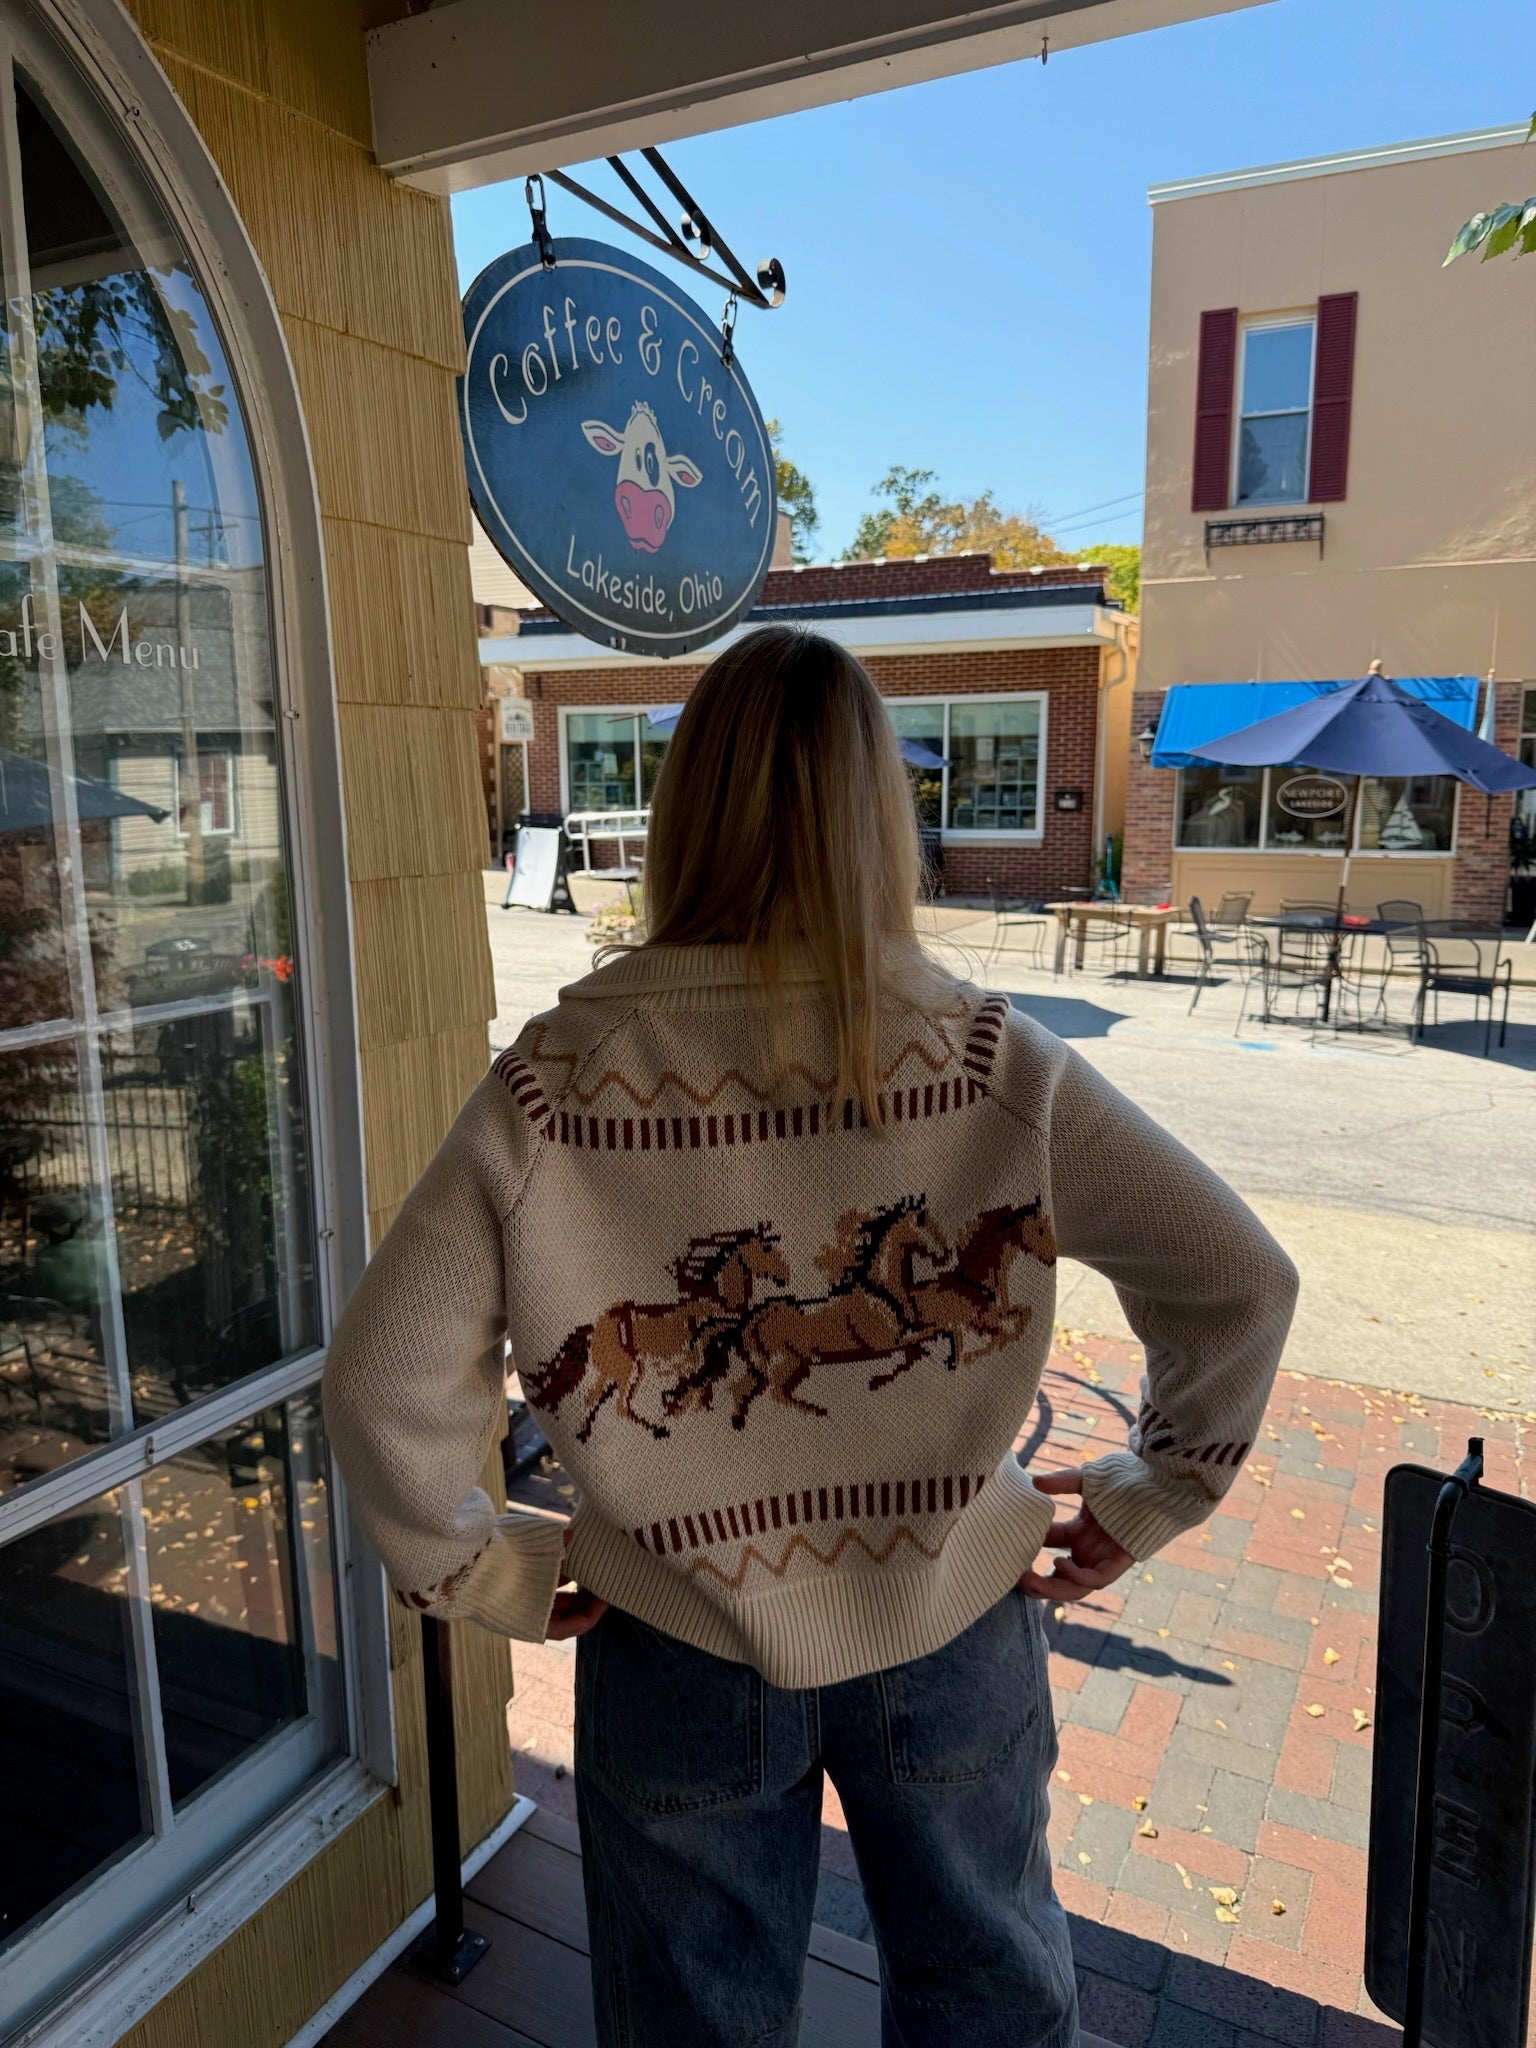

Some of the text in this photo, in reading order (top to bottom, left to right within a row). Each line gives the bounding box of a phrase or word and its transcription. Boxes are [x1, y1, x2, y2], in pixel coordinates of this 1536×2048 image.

[489, 297, 762, 527] Coffee & Cream
[566, 535, 723, 622] Lakeside, Ohio
[0, 593, 200, 670] afe Menu
